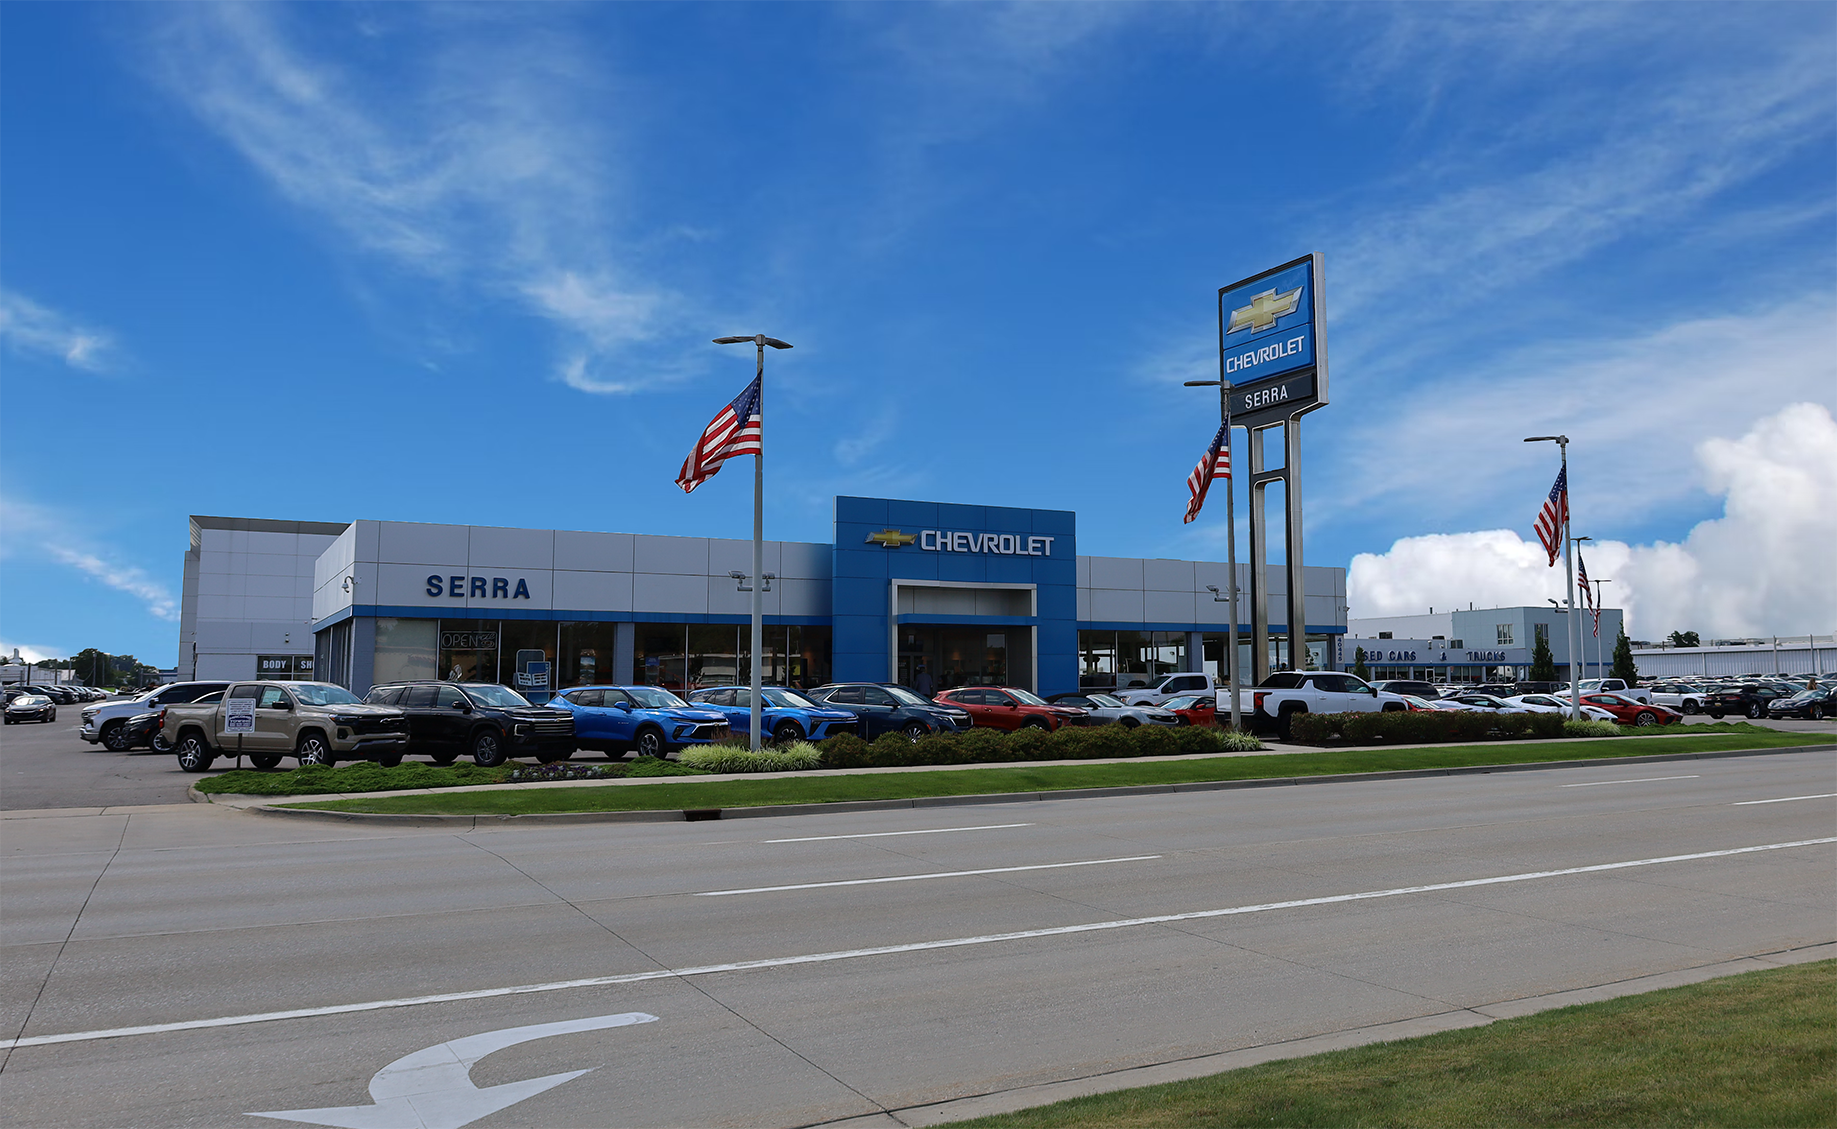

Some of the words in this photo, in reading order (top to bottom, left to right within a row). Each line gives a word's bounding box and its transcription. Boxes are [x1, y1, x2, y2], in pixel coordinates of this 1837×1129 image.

[1226, 335, 1305, 373] CHEVROLET
[1245, 385, 1288, 409] SERRA
[921, 529, 1055, 556] CHEVROLET
[426, 574, 531, 599] SERRA
[442, 633, 478, 648] OPEN
[262, 660, 287, 669] BODY
[1354, 650, 1383, 661] SED
[1388, 650, 1417, 661] CARS
[1466, 651, 1507, 662] TRUCKS
